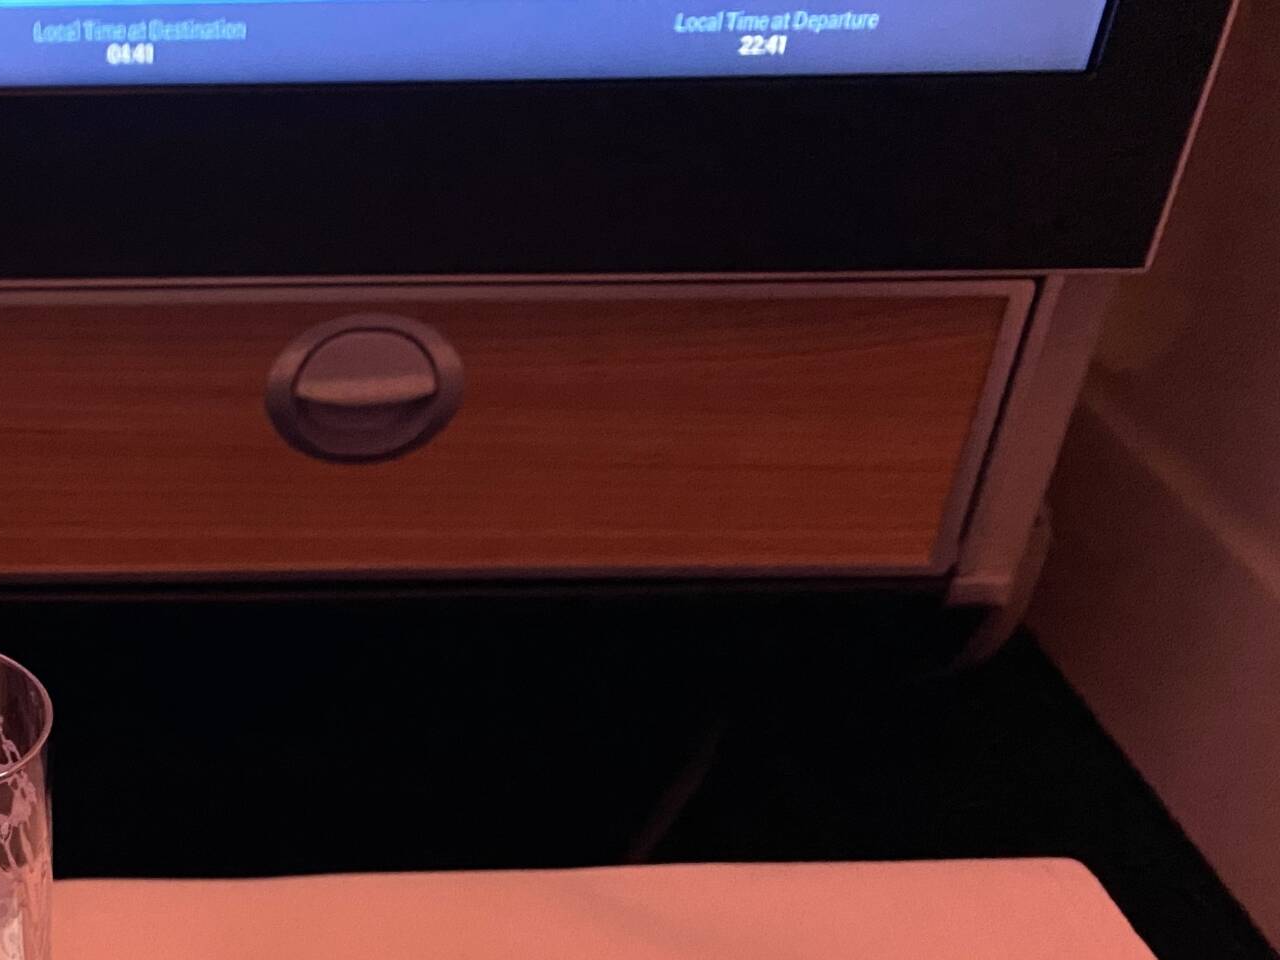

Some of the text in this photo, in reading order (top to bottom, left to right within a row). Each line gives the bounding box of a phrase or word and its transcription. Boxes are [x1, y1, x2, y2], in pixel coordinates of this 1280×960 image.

[675, 10, 880, 33] Local Time at Departure
[738, 34, 787, 56] 22:41
